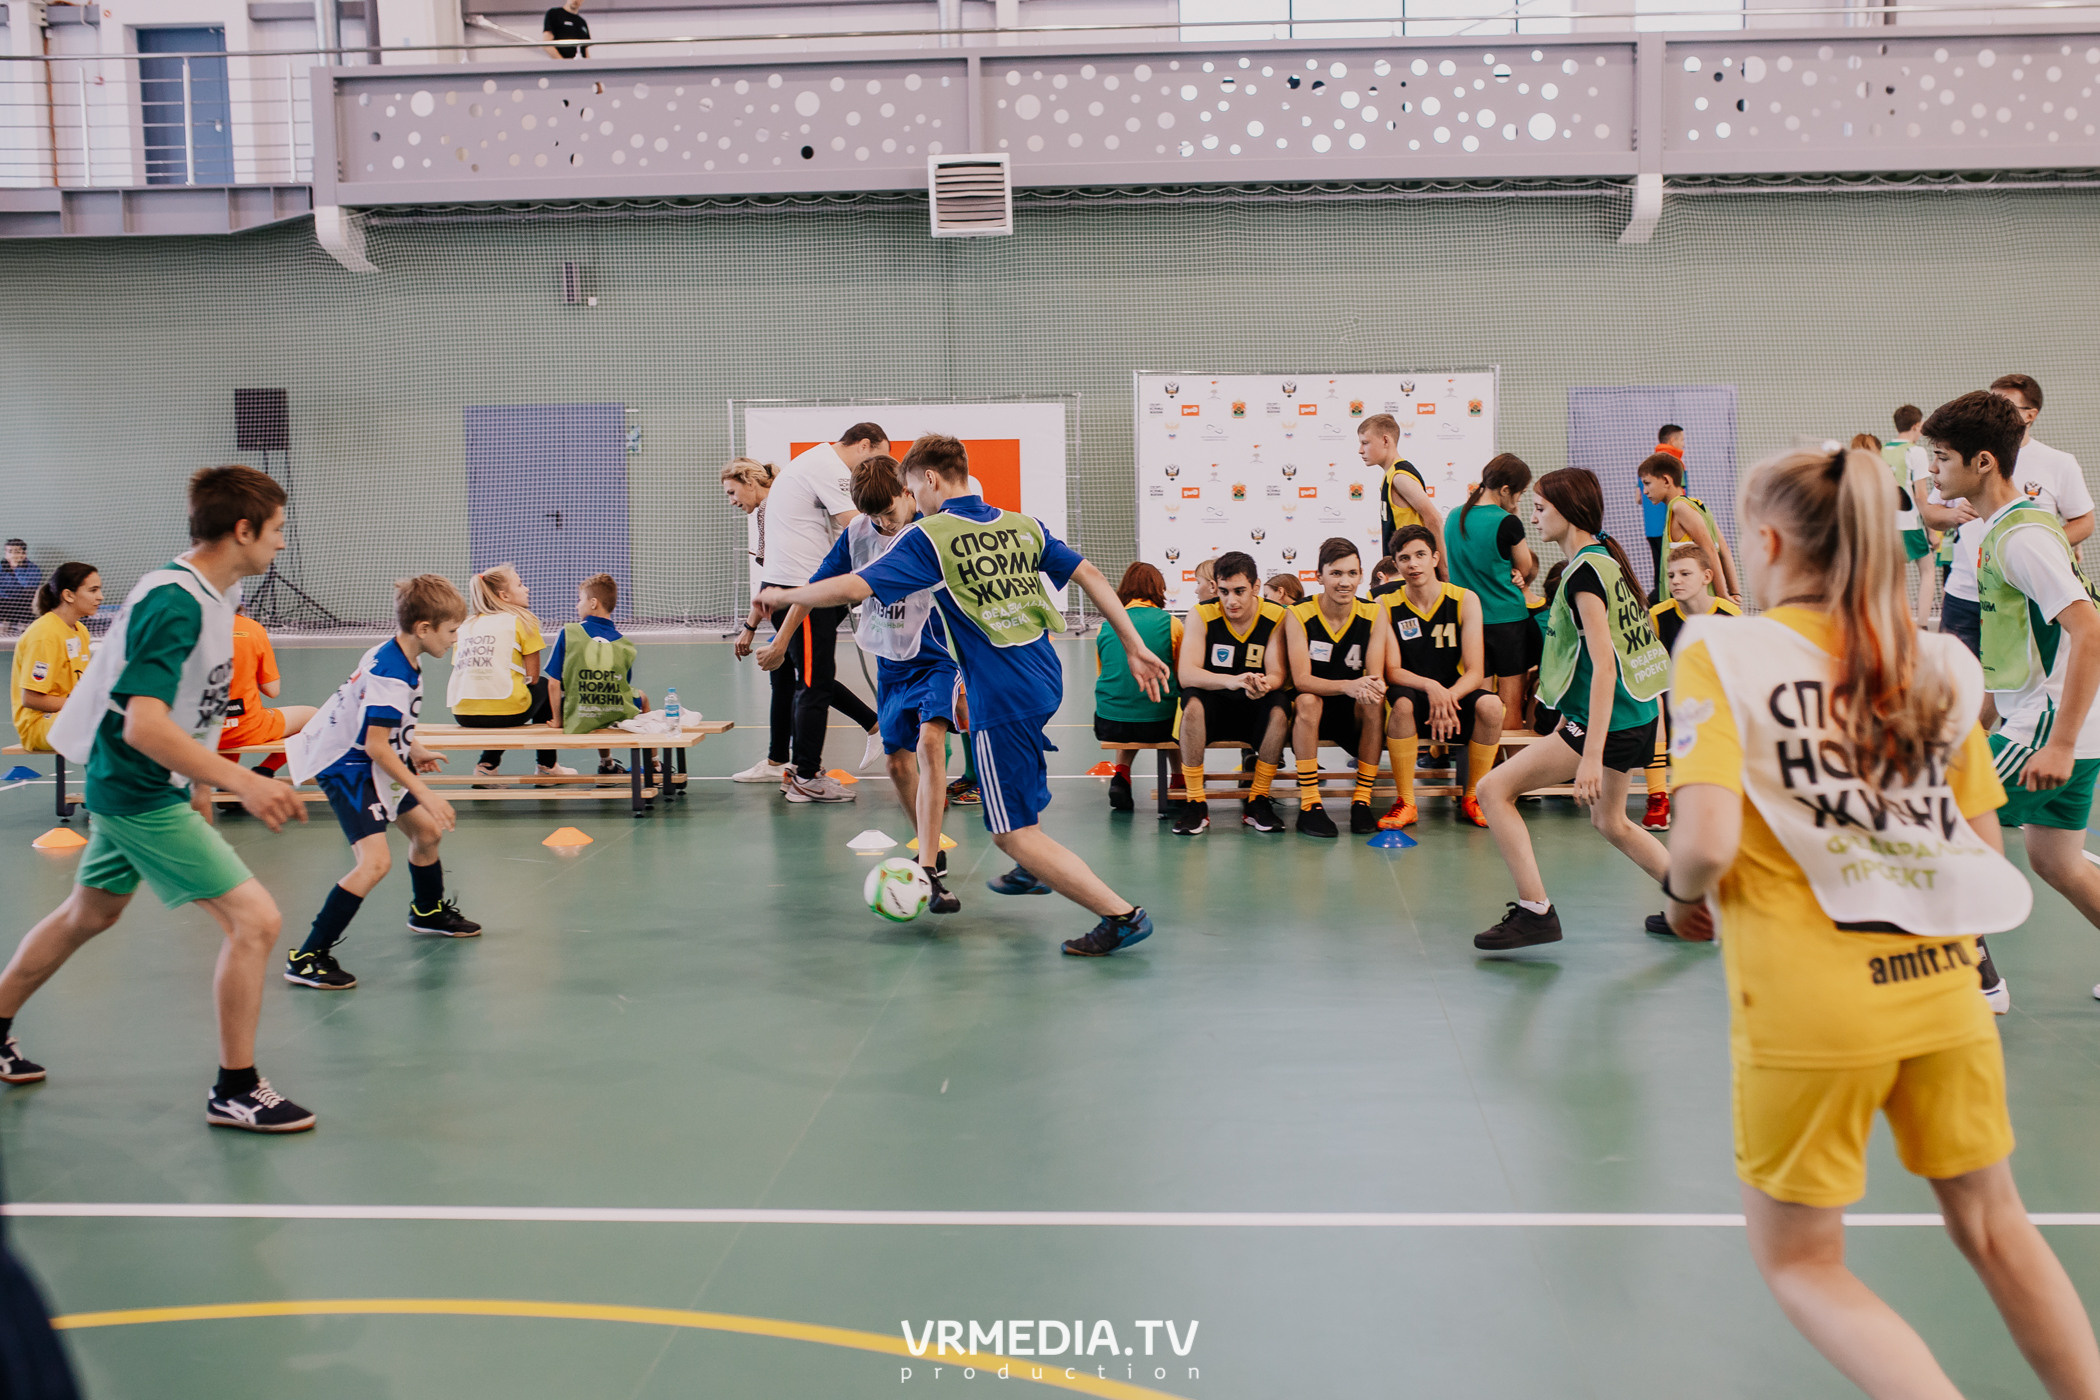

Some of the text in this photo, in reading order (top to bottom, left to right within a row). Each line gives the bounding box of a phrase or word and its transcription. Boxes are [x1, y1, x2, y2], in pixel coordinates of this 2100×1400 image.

[951, 529, 1021, 557] СПОРТ
[957, 551, 1039, 585] НОРМА
[1430, 623, 1457, 649] 11
[1245, 643, 1265, 668] 9
[1344, 644, 1362, 671] 4
[578, 669, 615, 681] СПОРТ
[1634, 660, 1668, 684] ПРОЕКТ
[579, 693, 624, 706] ЖИЗНИ
